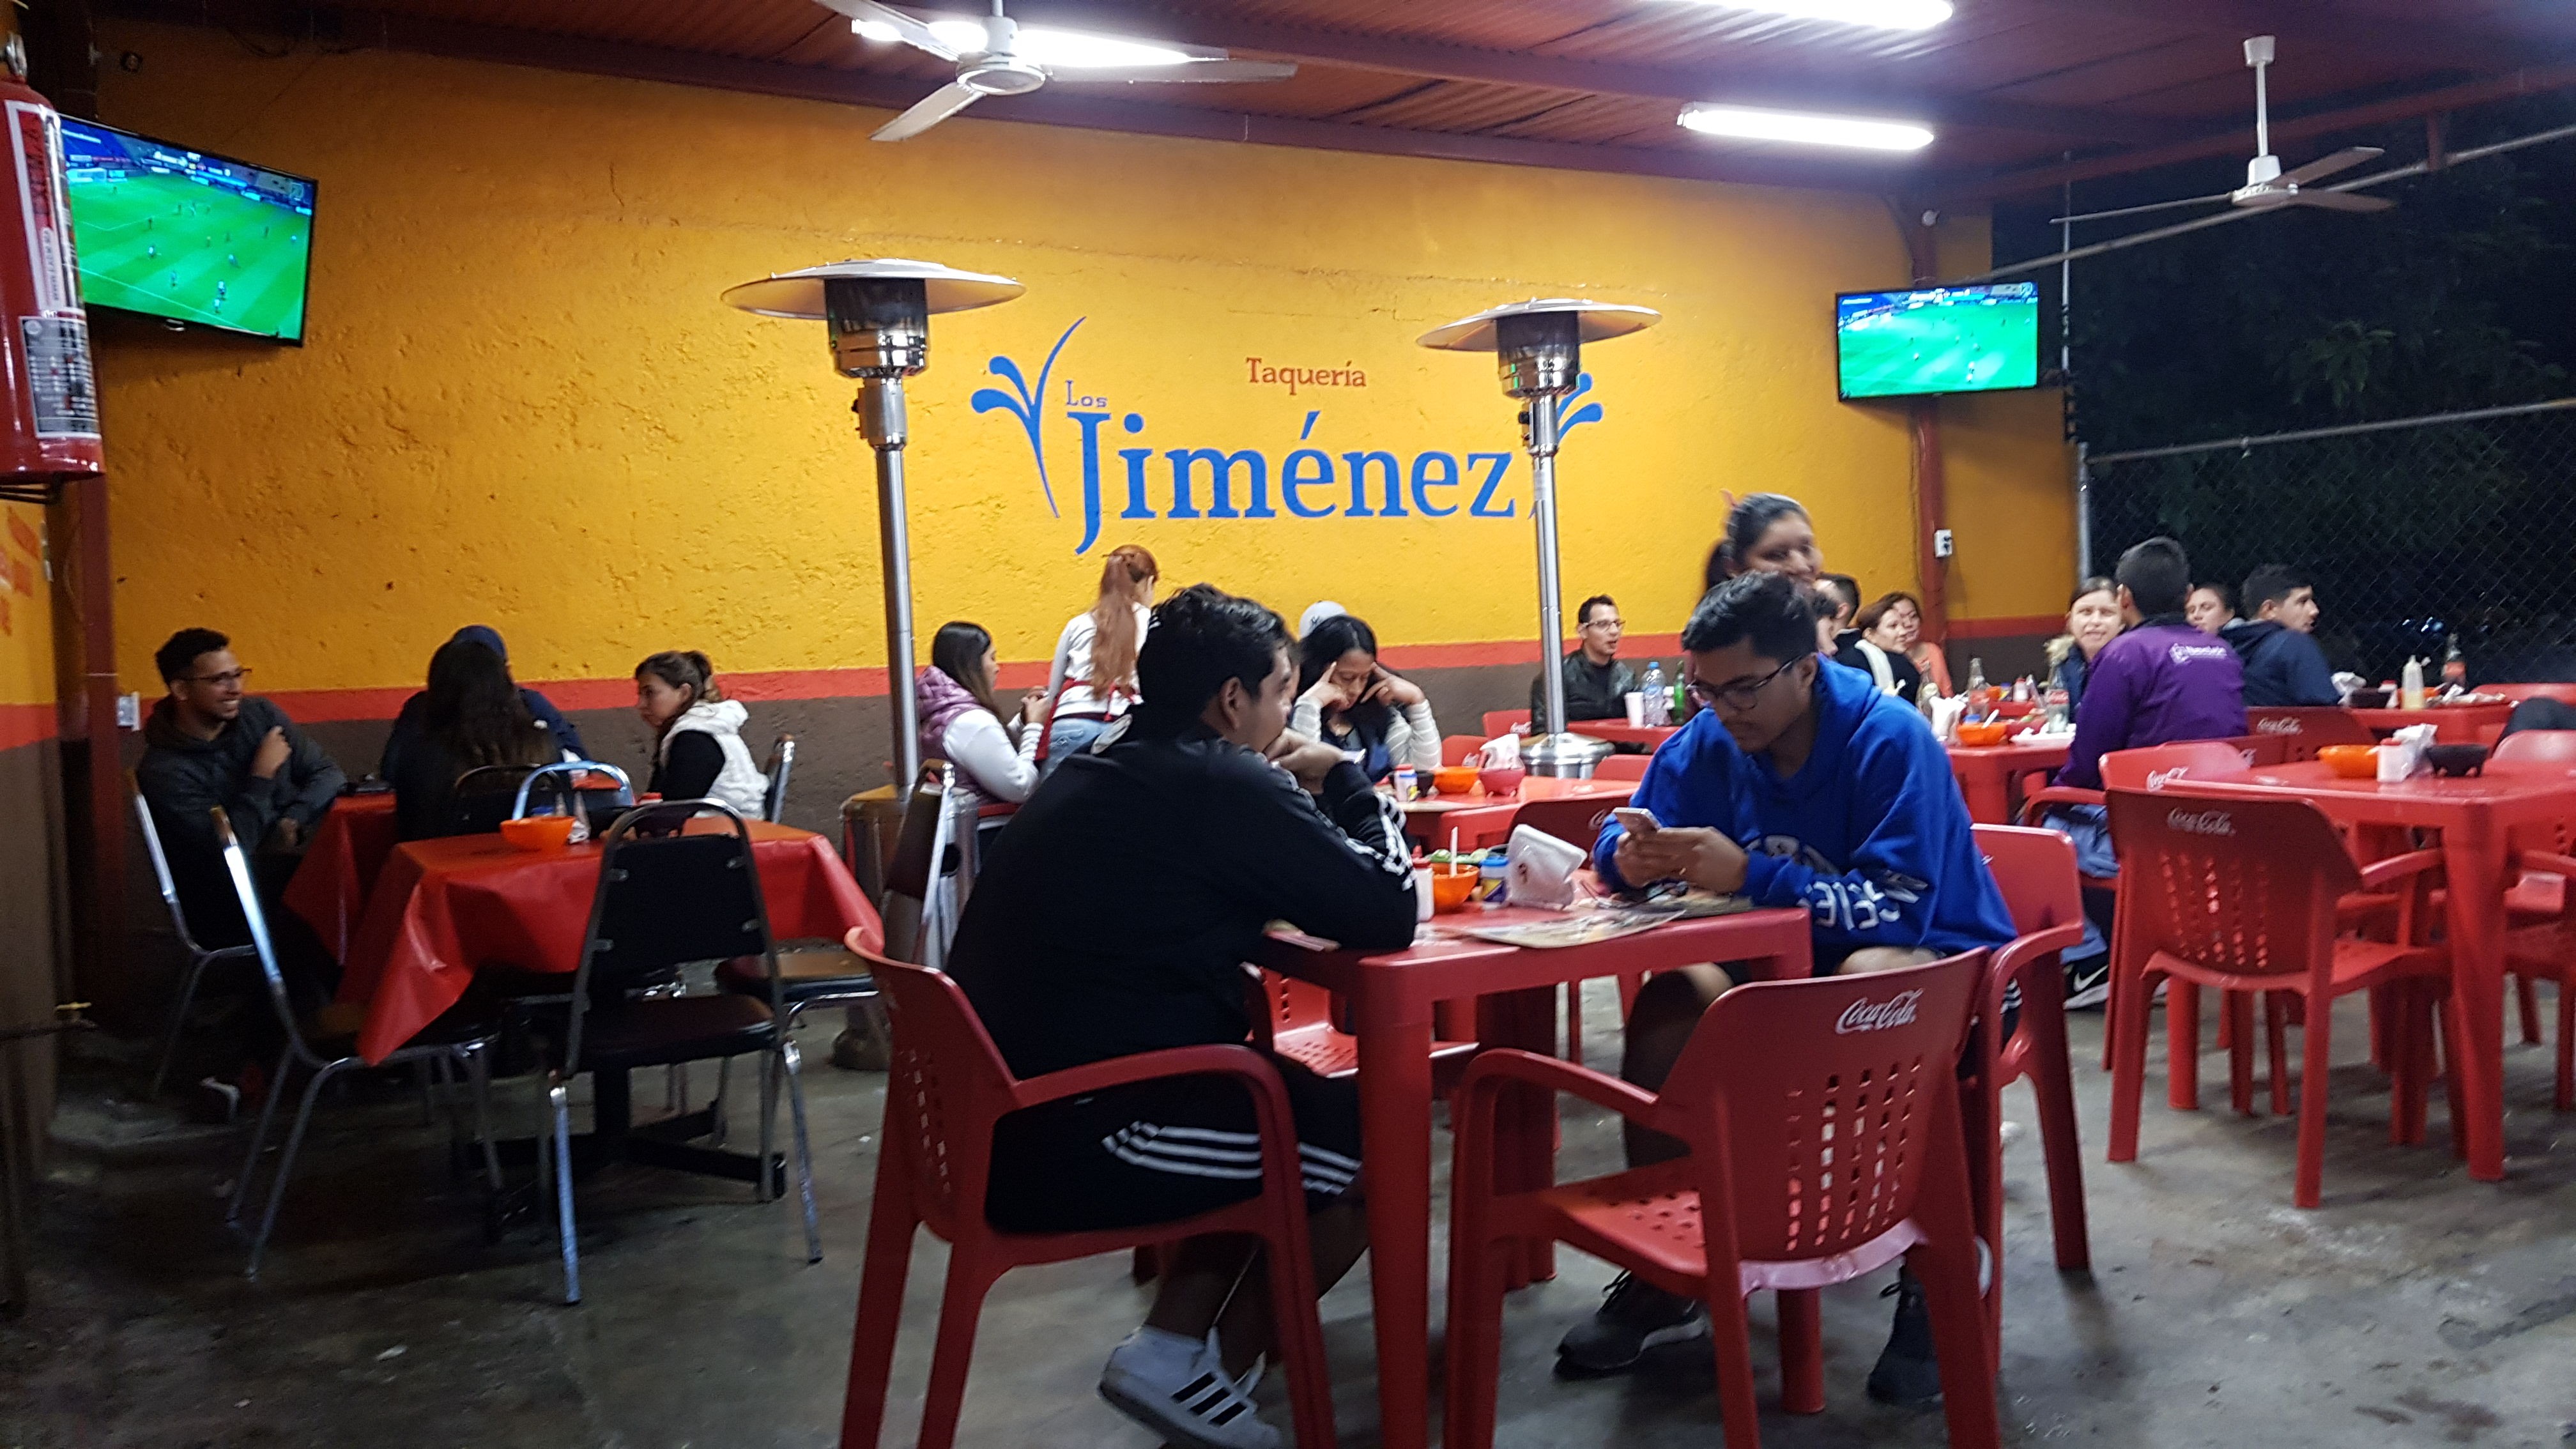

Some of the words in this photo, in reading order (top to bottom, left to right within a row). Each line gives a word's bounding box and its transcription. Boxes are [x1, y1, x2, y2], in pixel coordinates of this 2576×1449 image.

[1066, 379, 1108, 408] Los
[1245, 357, 1367, 396] Taquería
[1067, 411, 1516, 555] Jiménez
